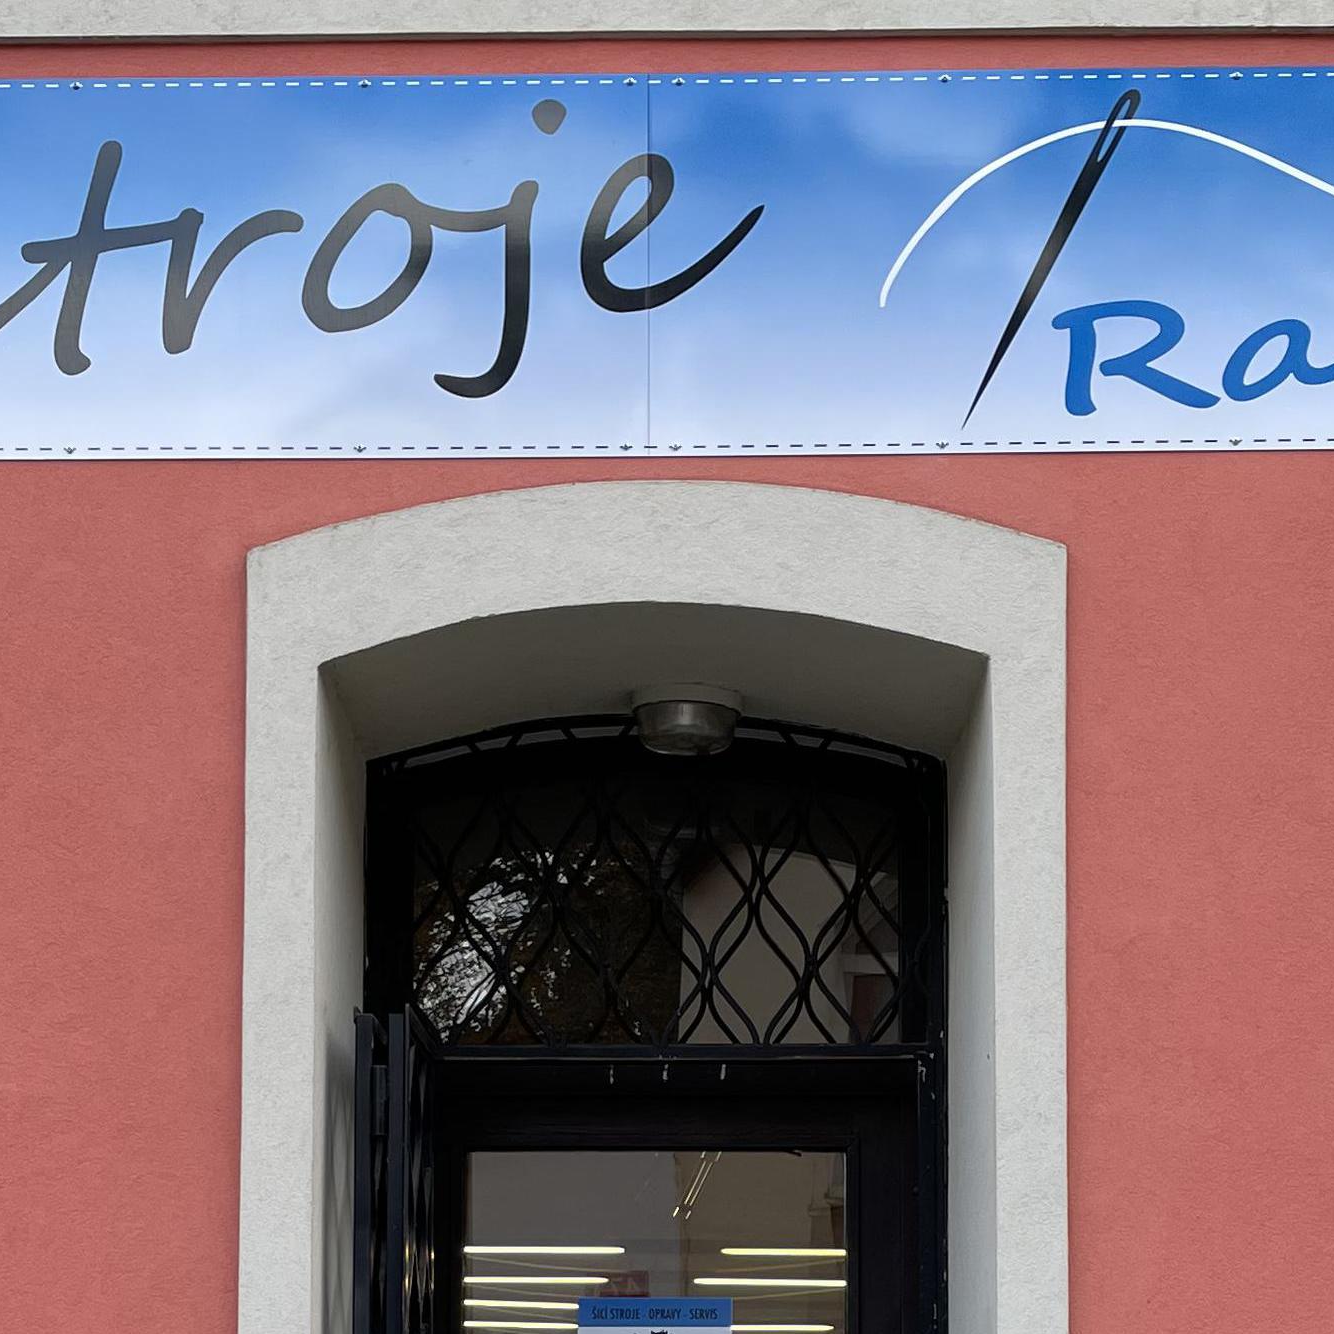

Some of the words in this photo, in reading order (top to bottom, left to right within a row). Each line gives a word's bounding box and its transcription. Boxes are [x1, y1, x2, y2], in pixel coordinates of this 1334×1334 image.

[591, 1306, 608, 1320] ŠICÍ
[609, 1308, 641, 1320] STROJE
[648, 1308, 682, 1320] OPRAVY
[689, 1308, 718, 1320] SERVIS
